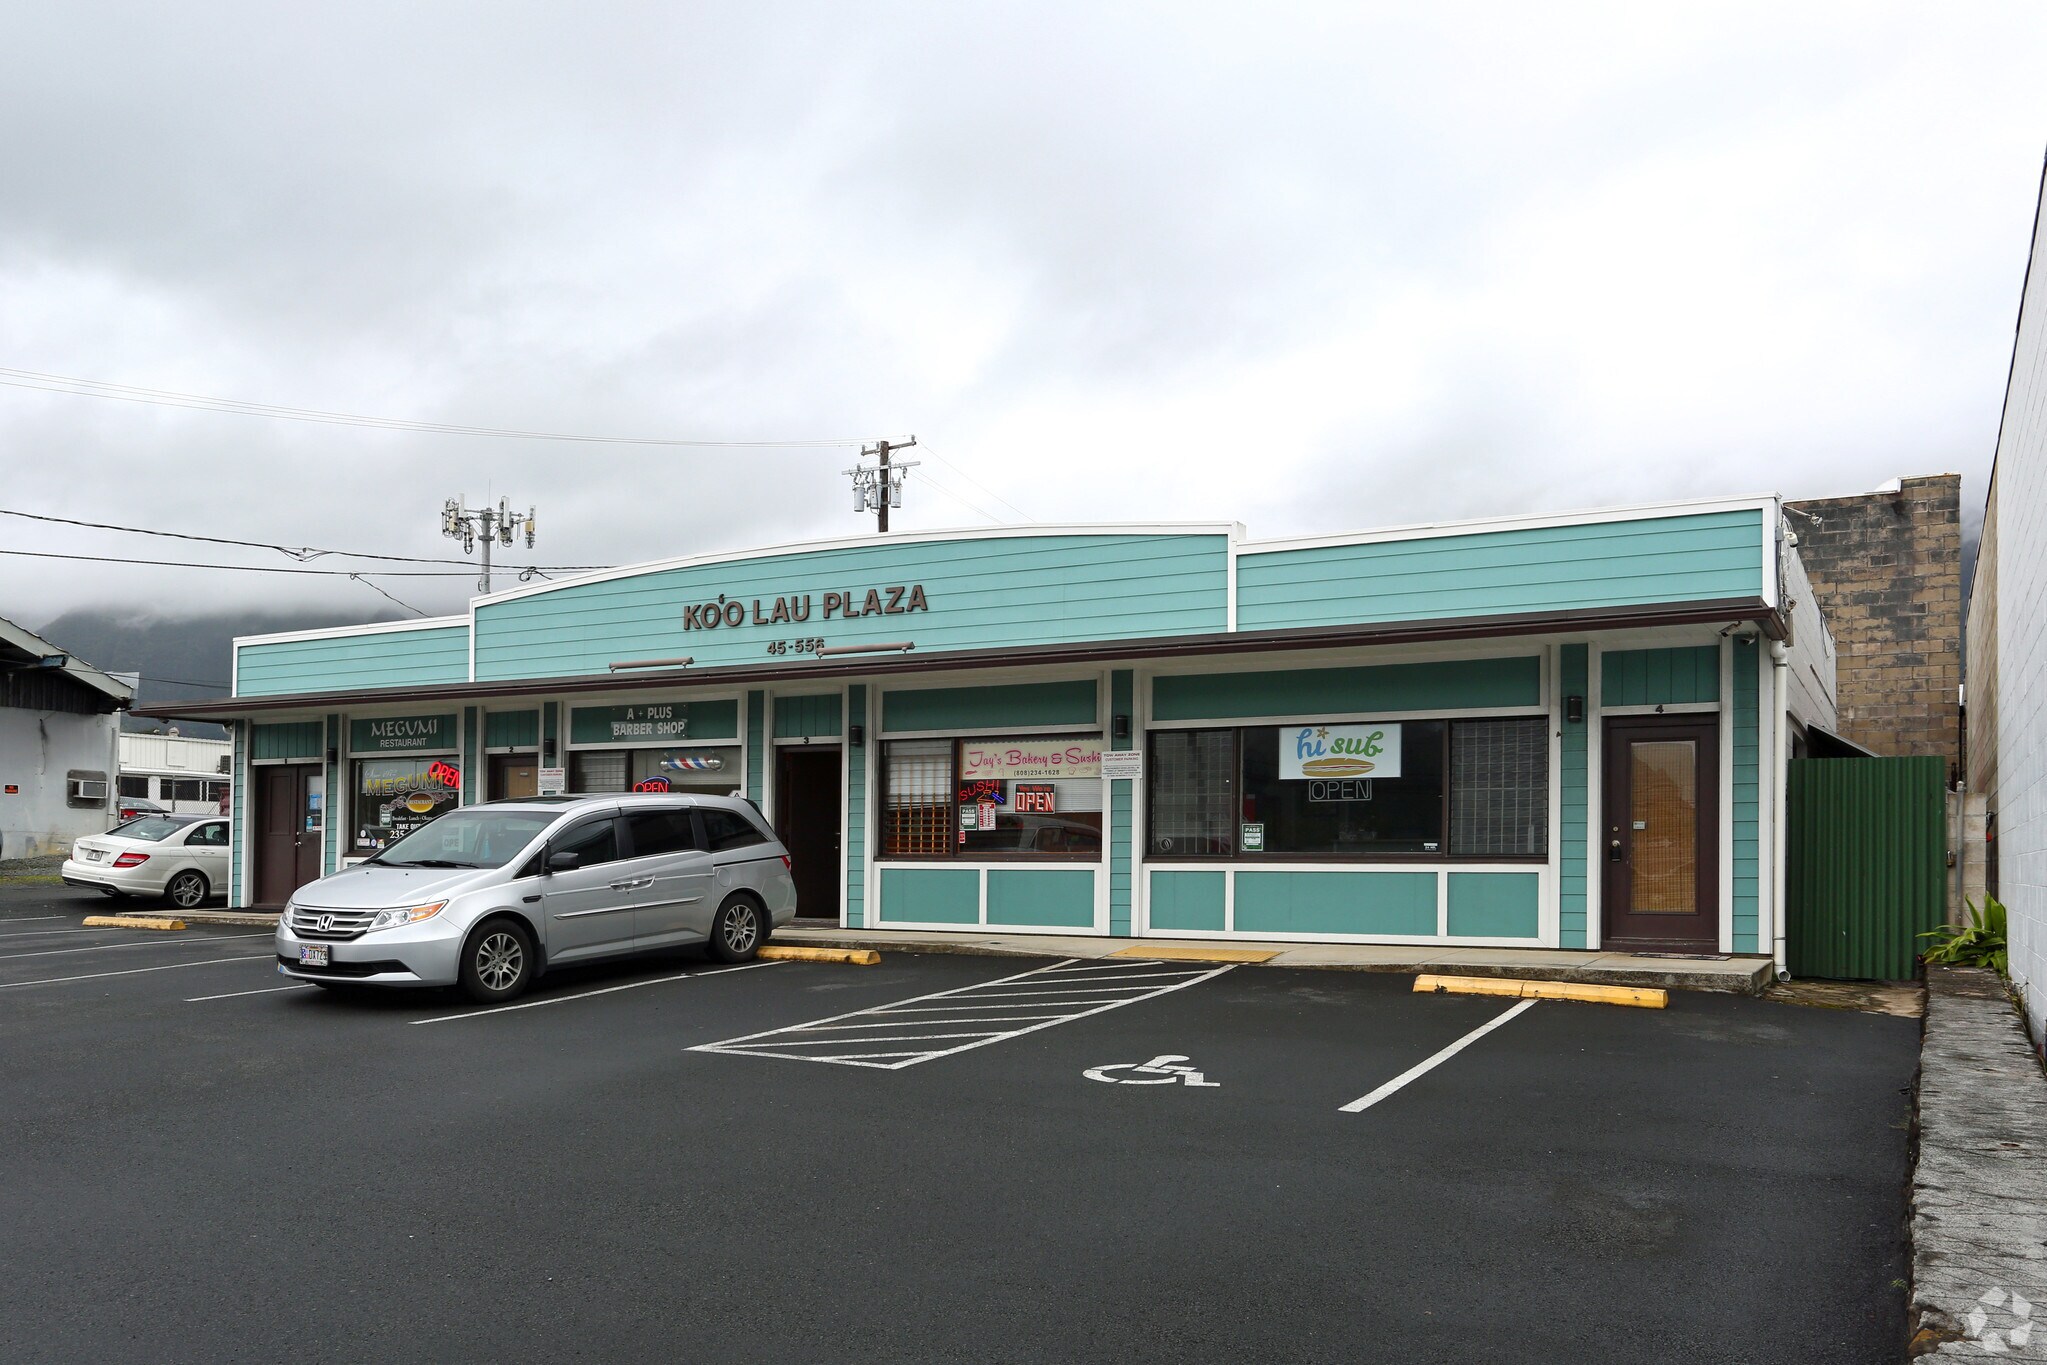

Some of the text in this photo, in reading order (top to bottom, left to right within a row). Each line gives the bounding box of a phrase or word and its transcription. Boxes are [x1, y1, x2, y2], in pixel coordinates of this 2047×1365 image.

[752, 595, 810, 625] LAU
[823, 584, 929, 619] PLAZA
[767, 637, 825, 655] 45-556
[627, 708, 634, 720] A
[647, 706, 672, 719] PLUS
[1655, 704, 1664, 714] 4
[371, 719, 438, 737] MEGUMI
[613, 721, 685, 736] BARBER SHOP
[380, 738, 427, 748] RESTAURANT
[803, 736, 809, 745] 3
[1296, 727, 1384, 759] hi sub
[969, 747, 1101, 768] Jay's Bakery & Sushi
[366, 772, 444, 797] MEGUMI
[428, 761, 460, 790] OPEN
[960, 779, 1000, 801] SUSHI
[1311, 781, 1370, 800] OPEN
[1016, 792, 1054, 812] OPEN
[443, 838, 459, 848] OPE
